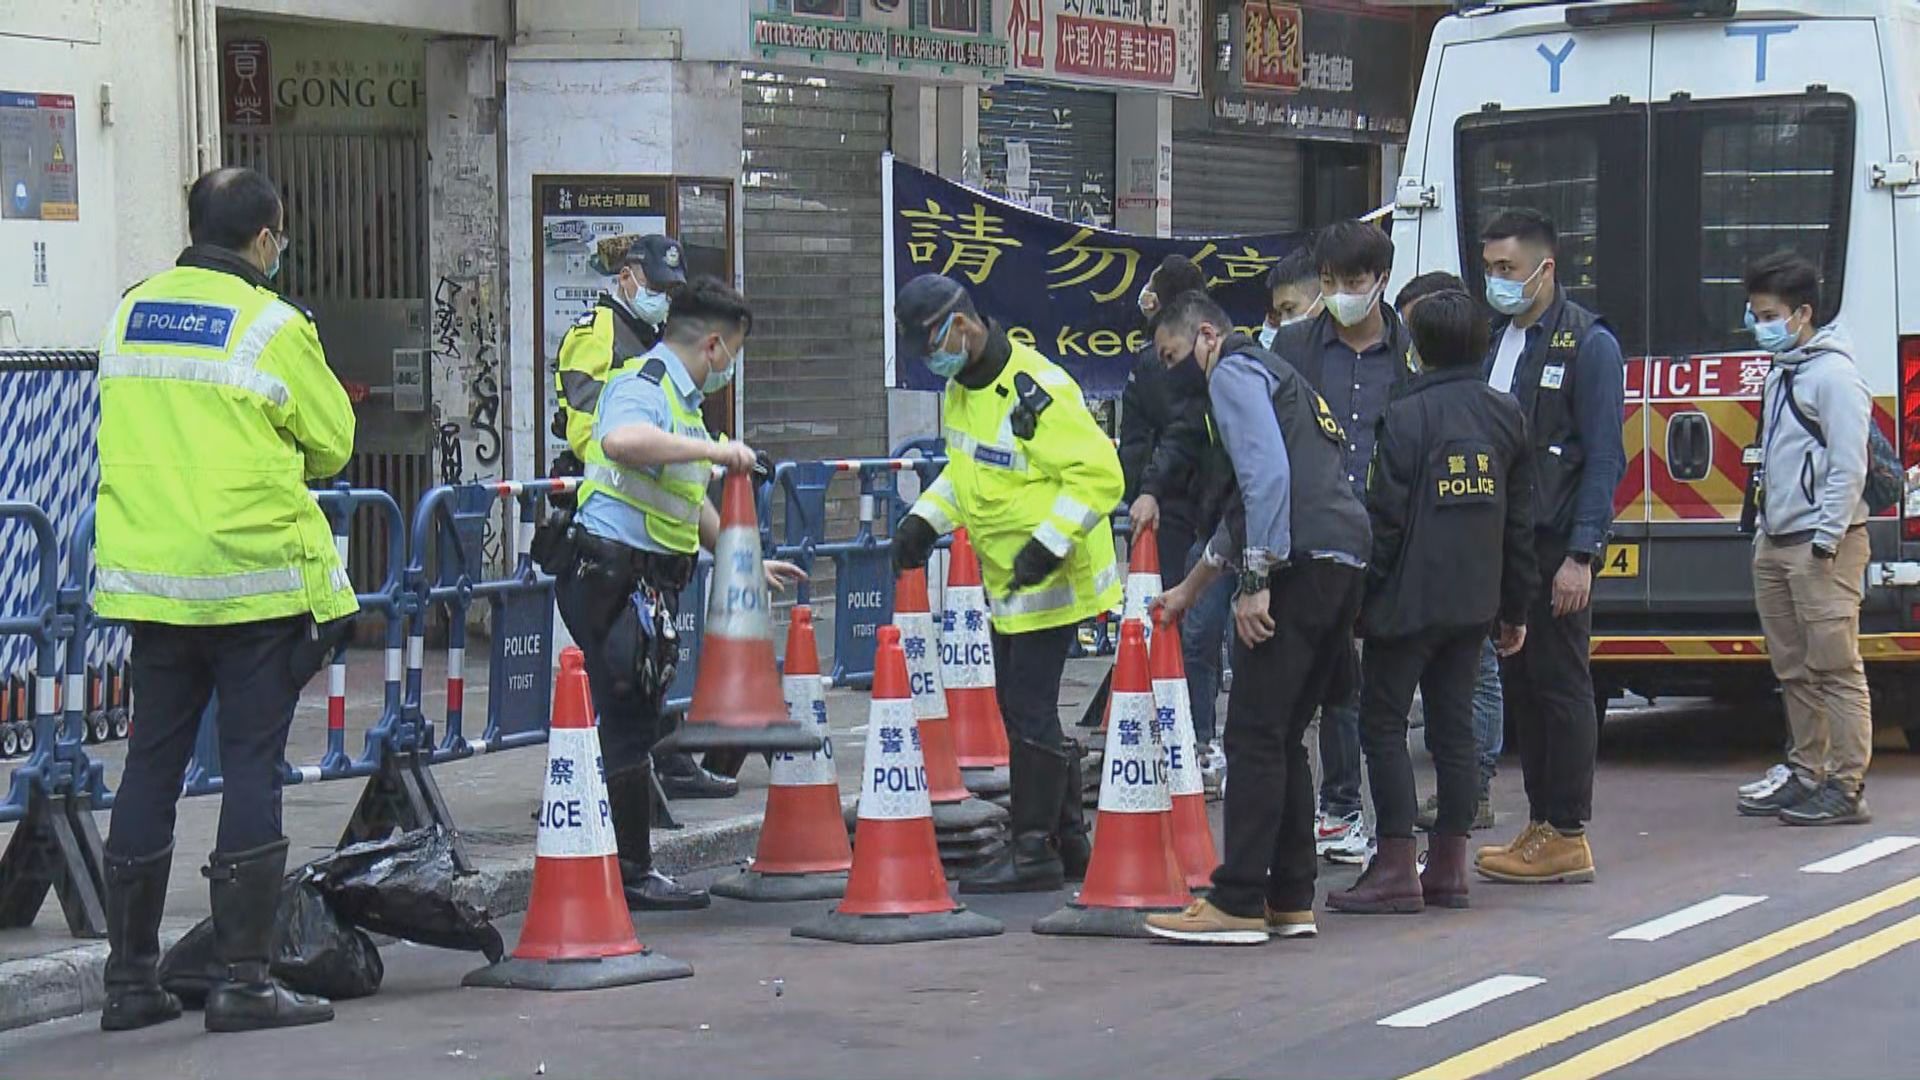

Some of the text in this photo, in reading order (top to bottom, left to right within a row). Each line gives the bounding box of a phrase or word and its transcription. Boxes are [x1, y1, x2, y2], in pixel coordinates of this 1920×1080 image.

[793, 25, 818, 49] BEAR
[819, 27, 834, 49] OF
[834, 29, 861, 53] HONG
[914, 38, 947, 60] BAKERY
[1062, 22, 1117, 69] 代理介紹
[1536, 24, 1799, 93] Y T
[277, 78, 426, 107] GONG CH
[147, 312, 207, 332] POLICE
[1623, 359, 1722, 397] LICE
[1739, 357, 1772, 393] 察
[1438, 476, 1495, 497] POLICE
[848, 591, 882, 609] POLICE
[504, 634, 540, 657] POLICE
[873, 766, 928, 793] POLIC
[1110, 759, 1169, 786] POLIC
